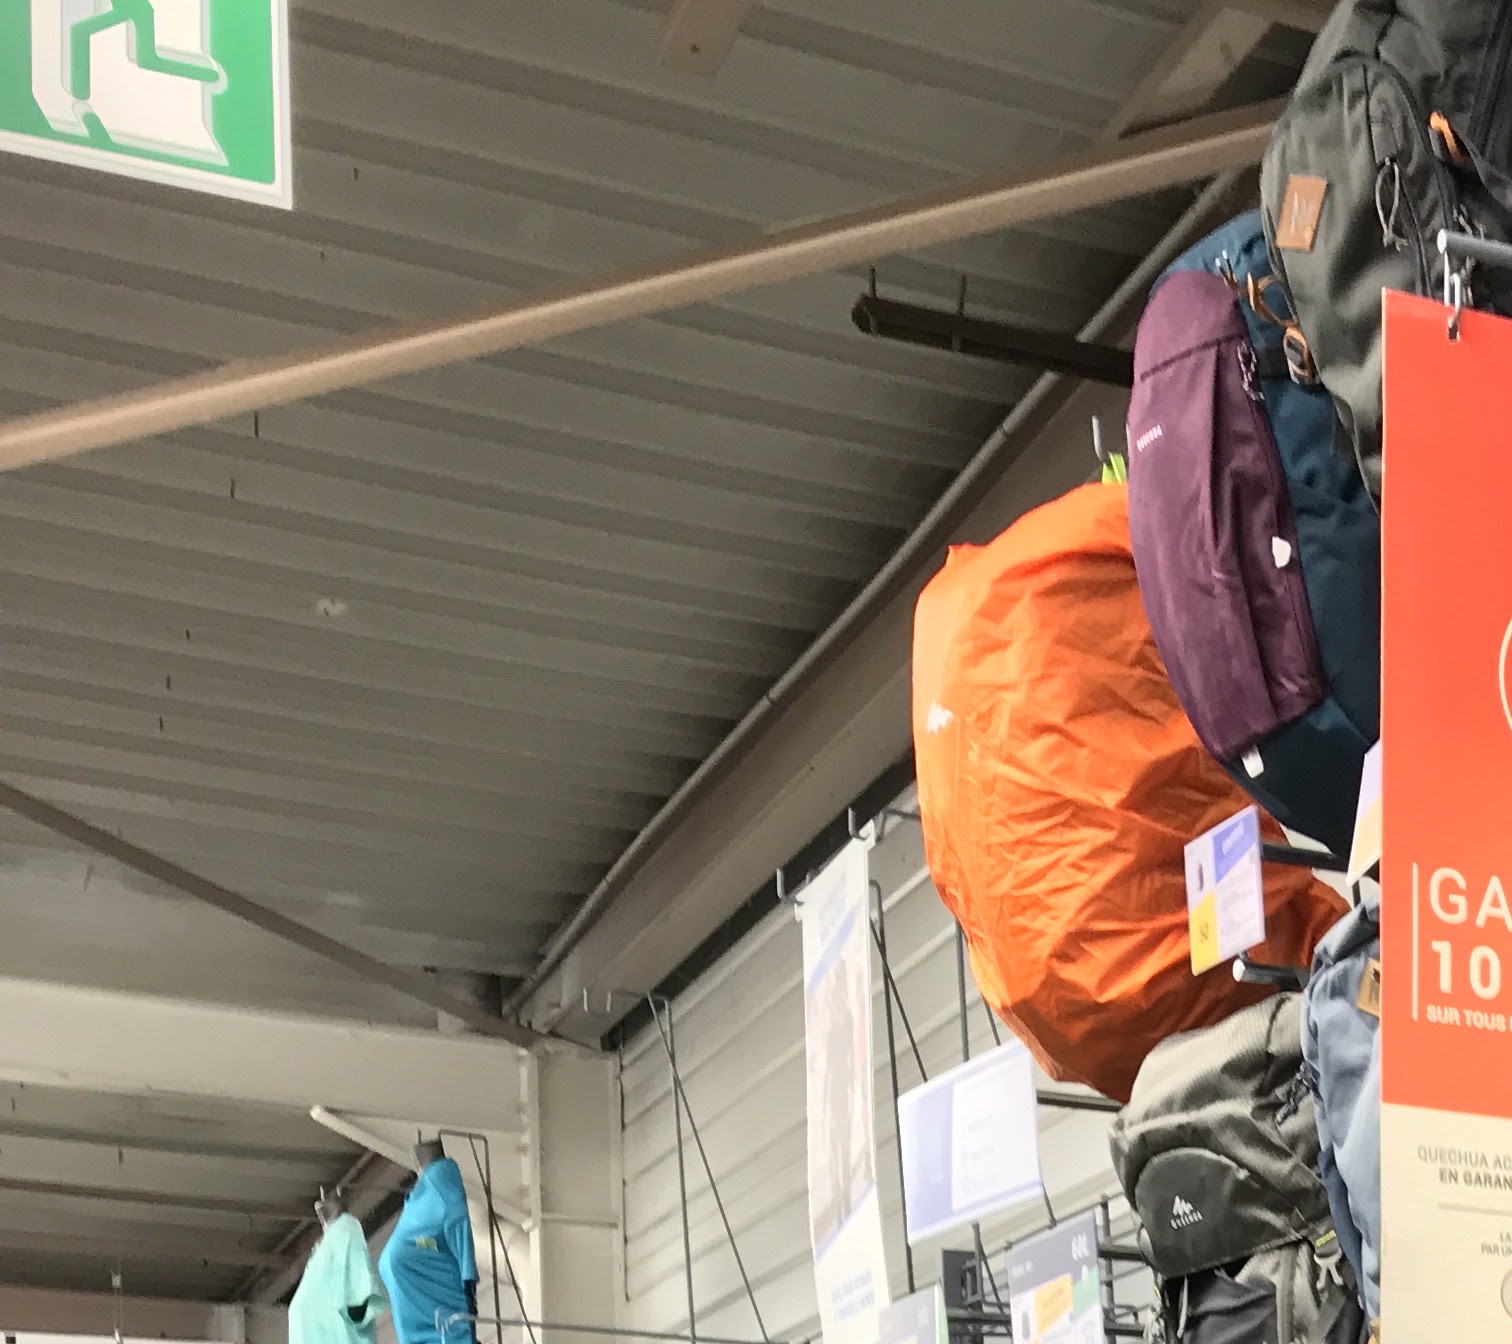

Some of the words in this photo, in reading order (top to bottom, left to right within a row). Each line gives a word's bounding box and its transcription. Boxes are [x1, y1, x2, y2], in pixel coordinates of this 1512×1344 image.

[1431, 940, 1501, 1000] 10
[1427, 1004, 1461, 1027] SUR
[1463, 1009, 1507, 1032] TOUS
[1416, 1144, 1489, 1169] QUECHUA
[1438, 1168, 1459, 1186] EN
[1500, 1231, 1512, 1244] LA
[1481, 1242, 1500, 1256] PAR
